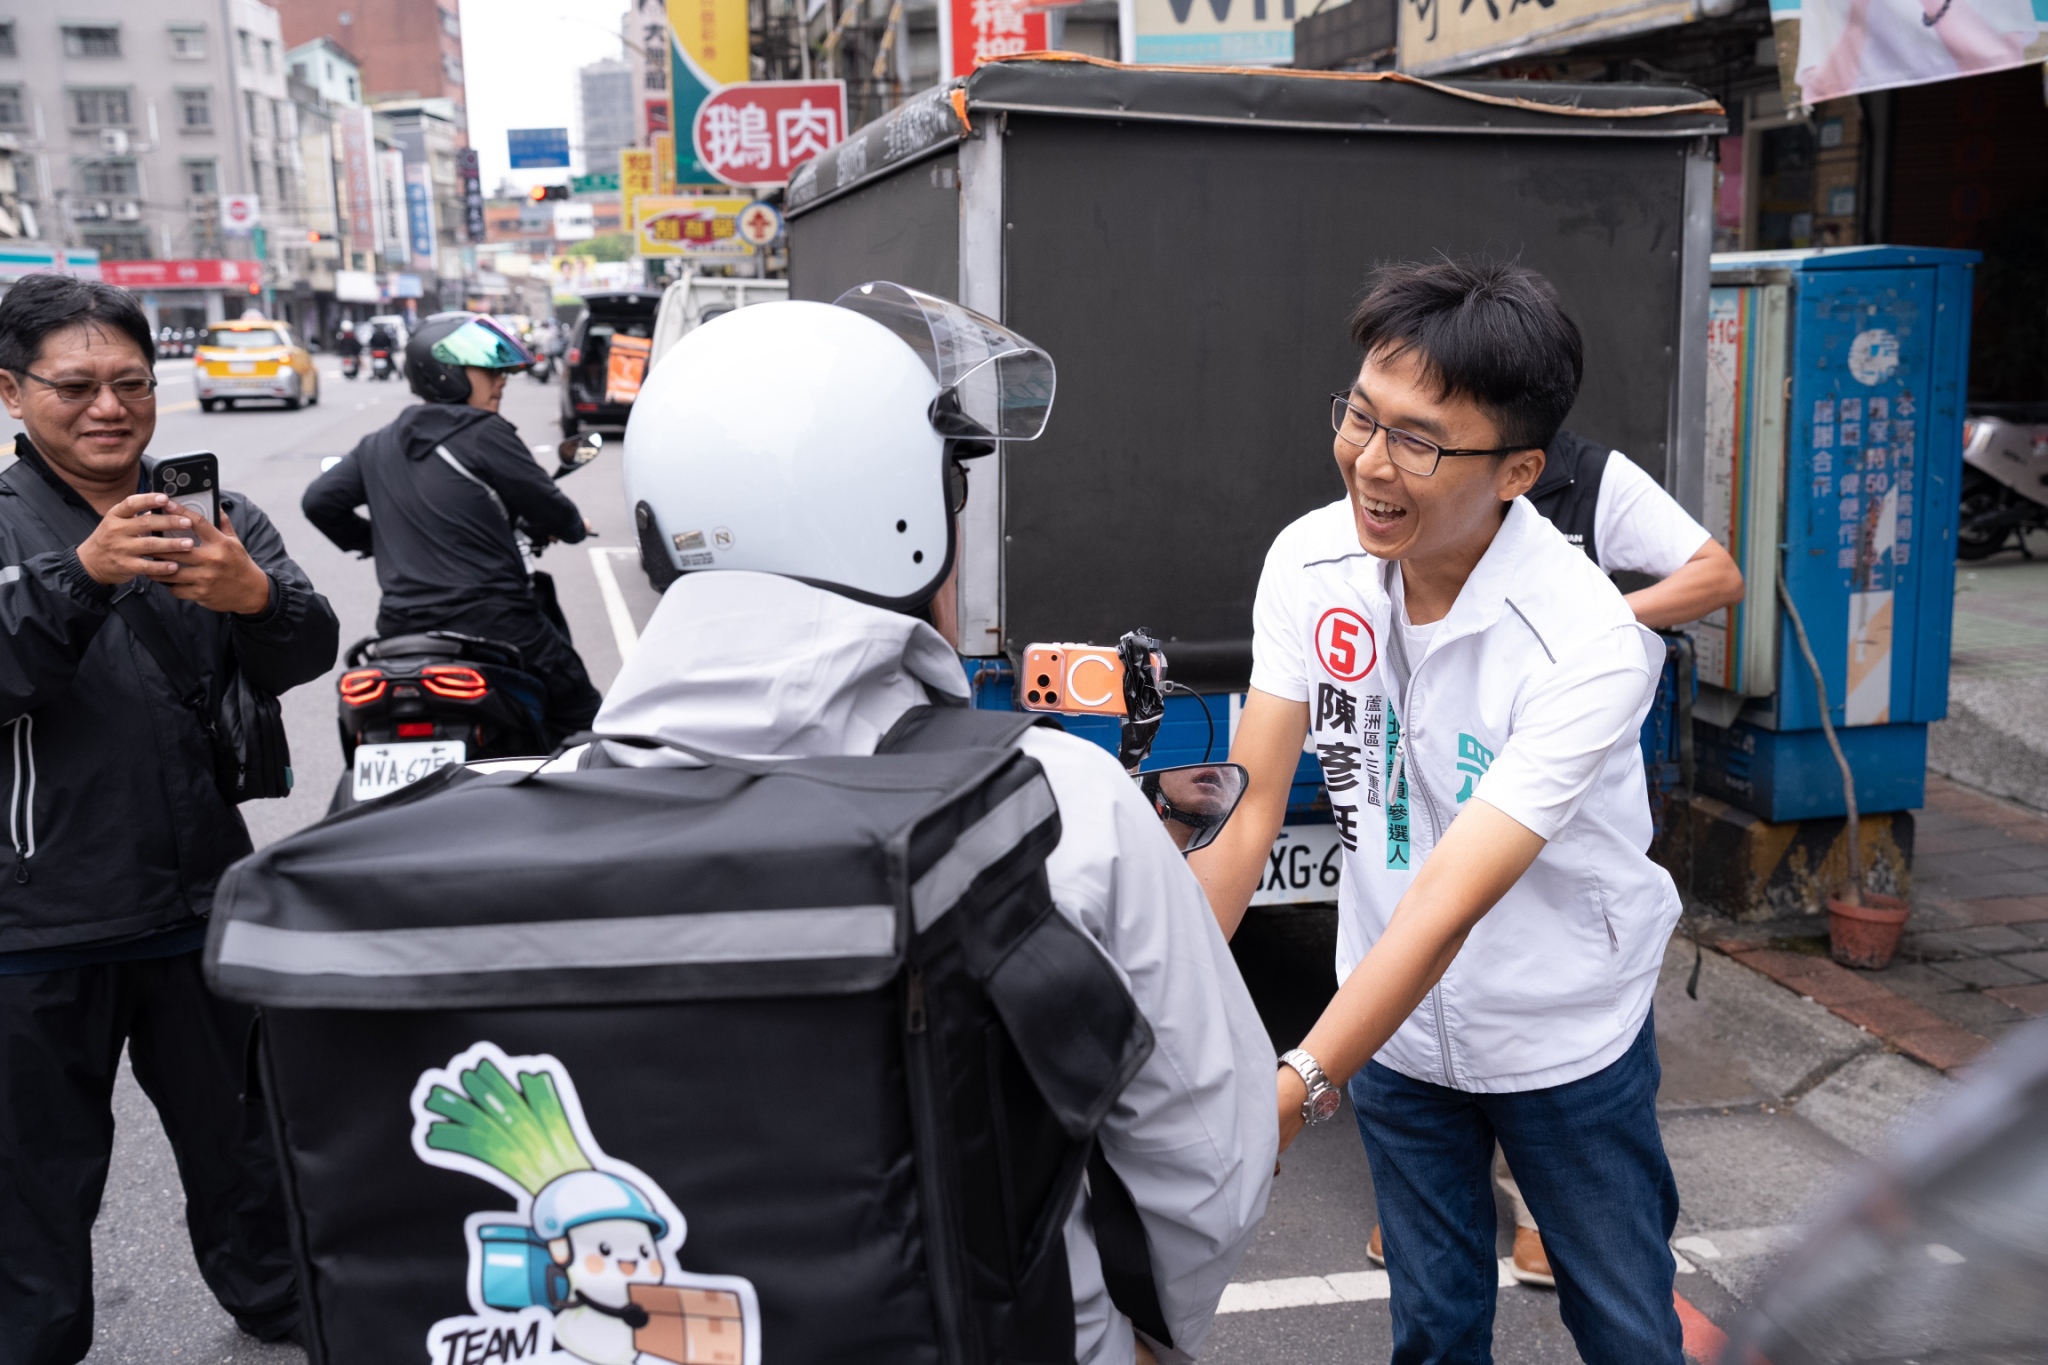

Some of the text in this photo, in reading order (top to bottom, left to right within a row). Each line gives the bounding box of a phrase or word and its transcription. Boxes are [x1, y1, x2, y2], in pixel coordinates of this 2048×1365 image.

[703, 99, 837, 170] 鵝肉
[1329, 618, 1359, 675] 5
[1315, 682, 1361, 853] 陳彥廷
[442, 1320, 540, 1365] TEAM
